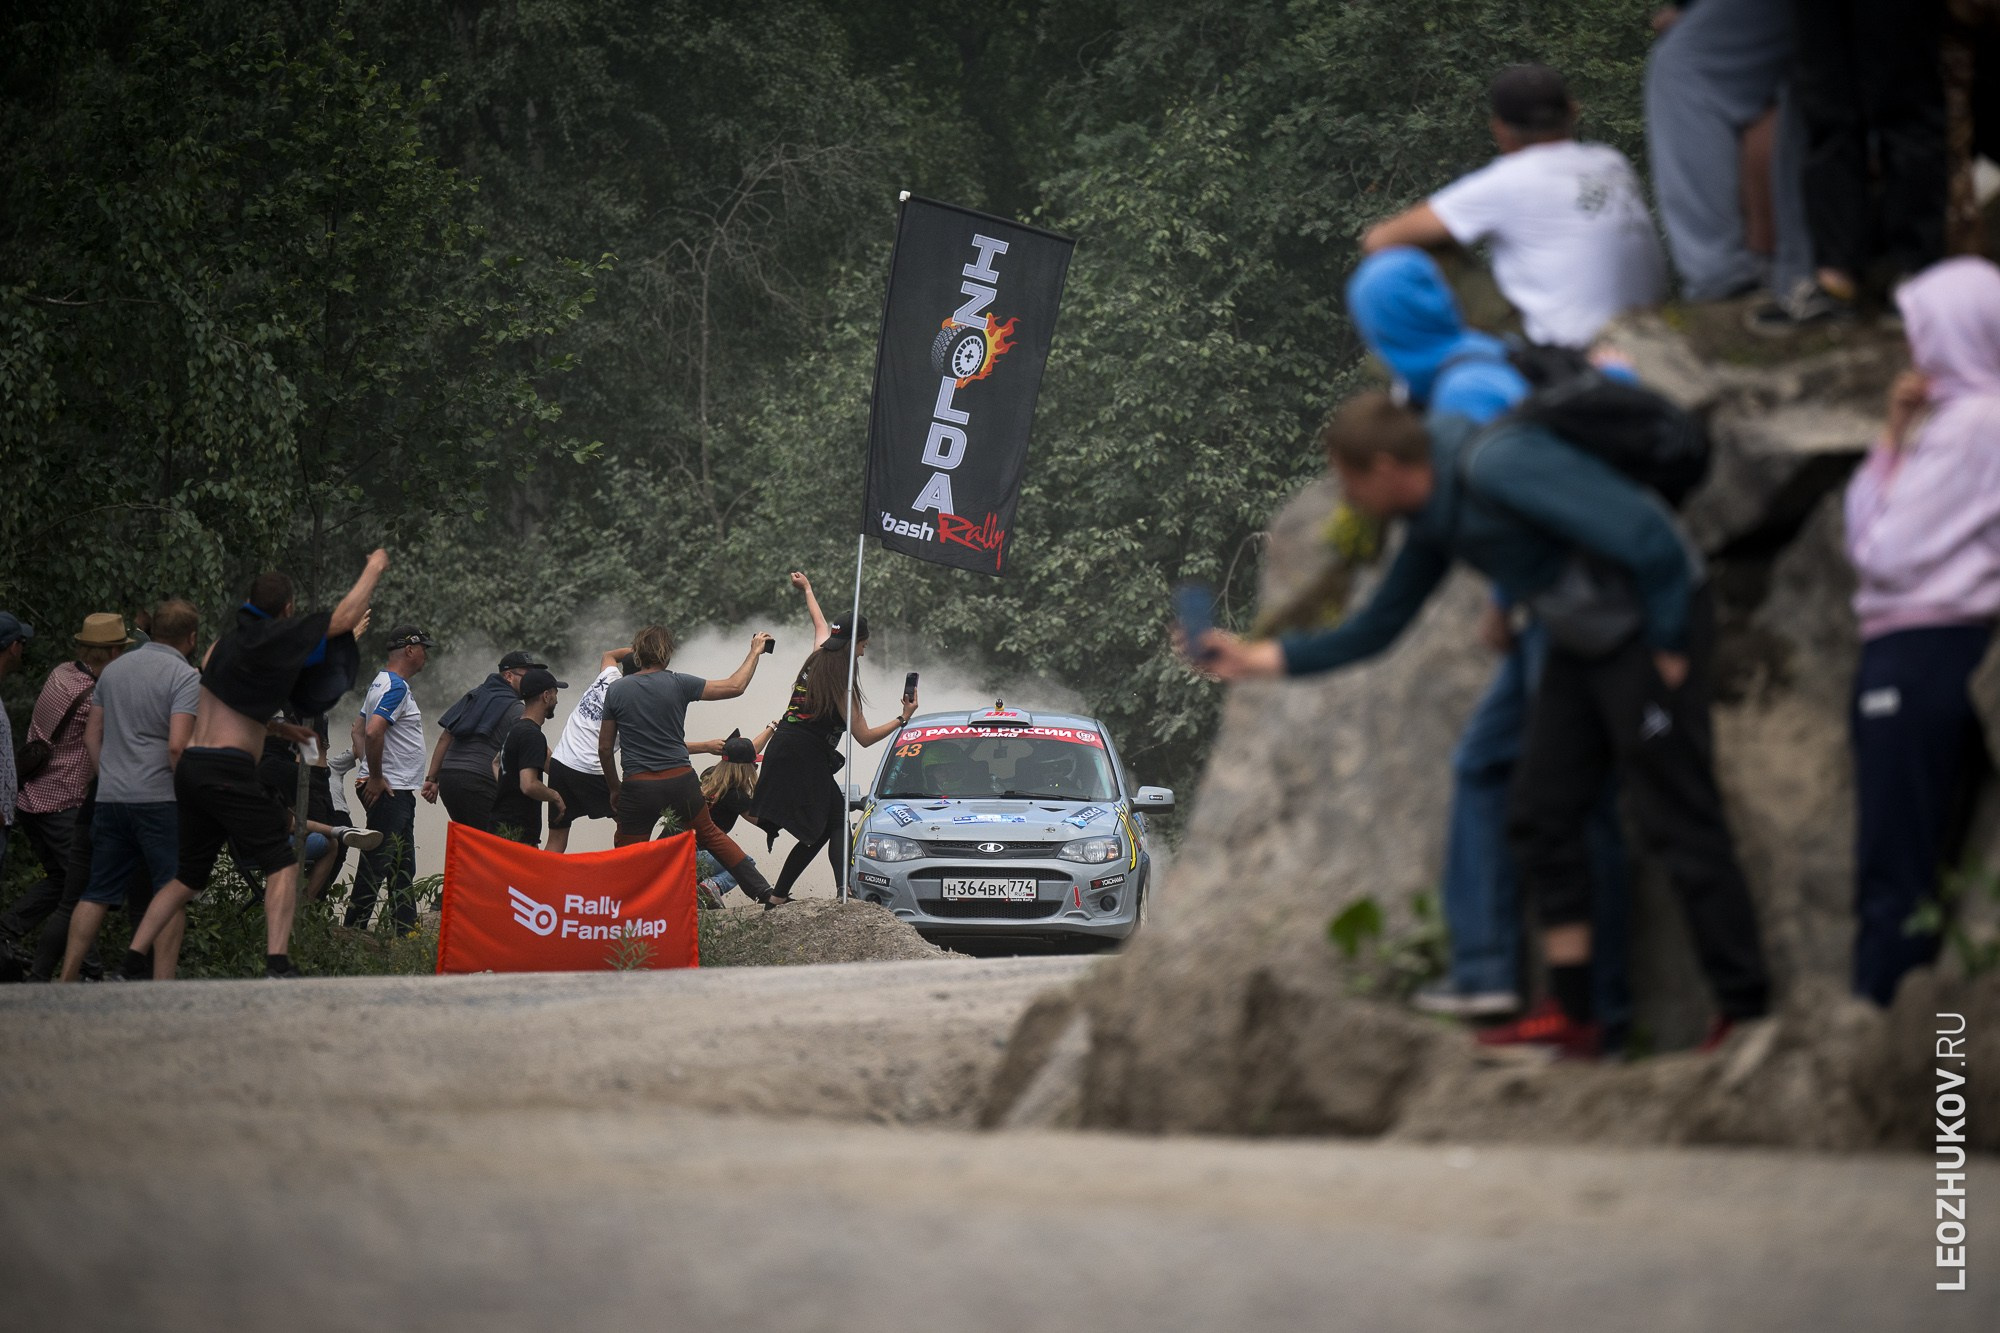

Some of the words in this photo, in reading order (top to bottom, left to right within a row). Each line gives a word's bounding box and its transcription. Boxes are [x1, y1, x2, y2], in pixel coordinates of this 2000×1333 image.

[937, 512, 1005, 571] Rally
[926, 727, 991, 737] РАЛЛИ
[998, 727, 1071, 738] РОССИИ
[895, 743, 923, 758] 43
[1009, 880, 1033, 893] 774
[564, 894, 622, 918] Rally
[561, 919, 622, 940] Fans
[624, 918, 667, 938] Map
